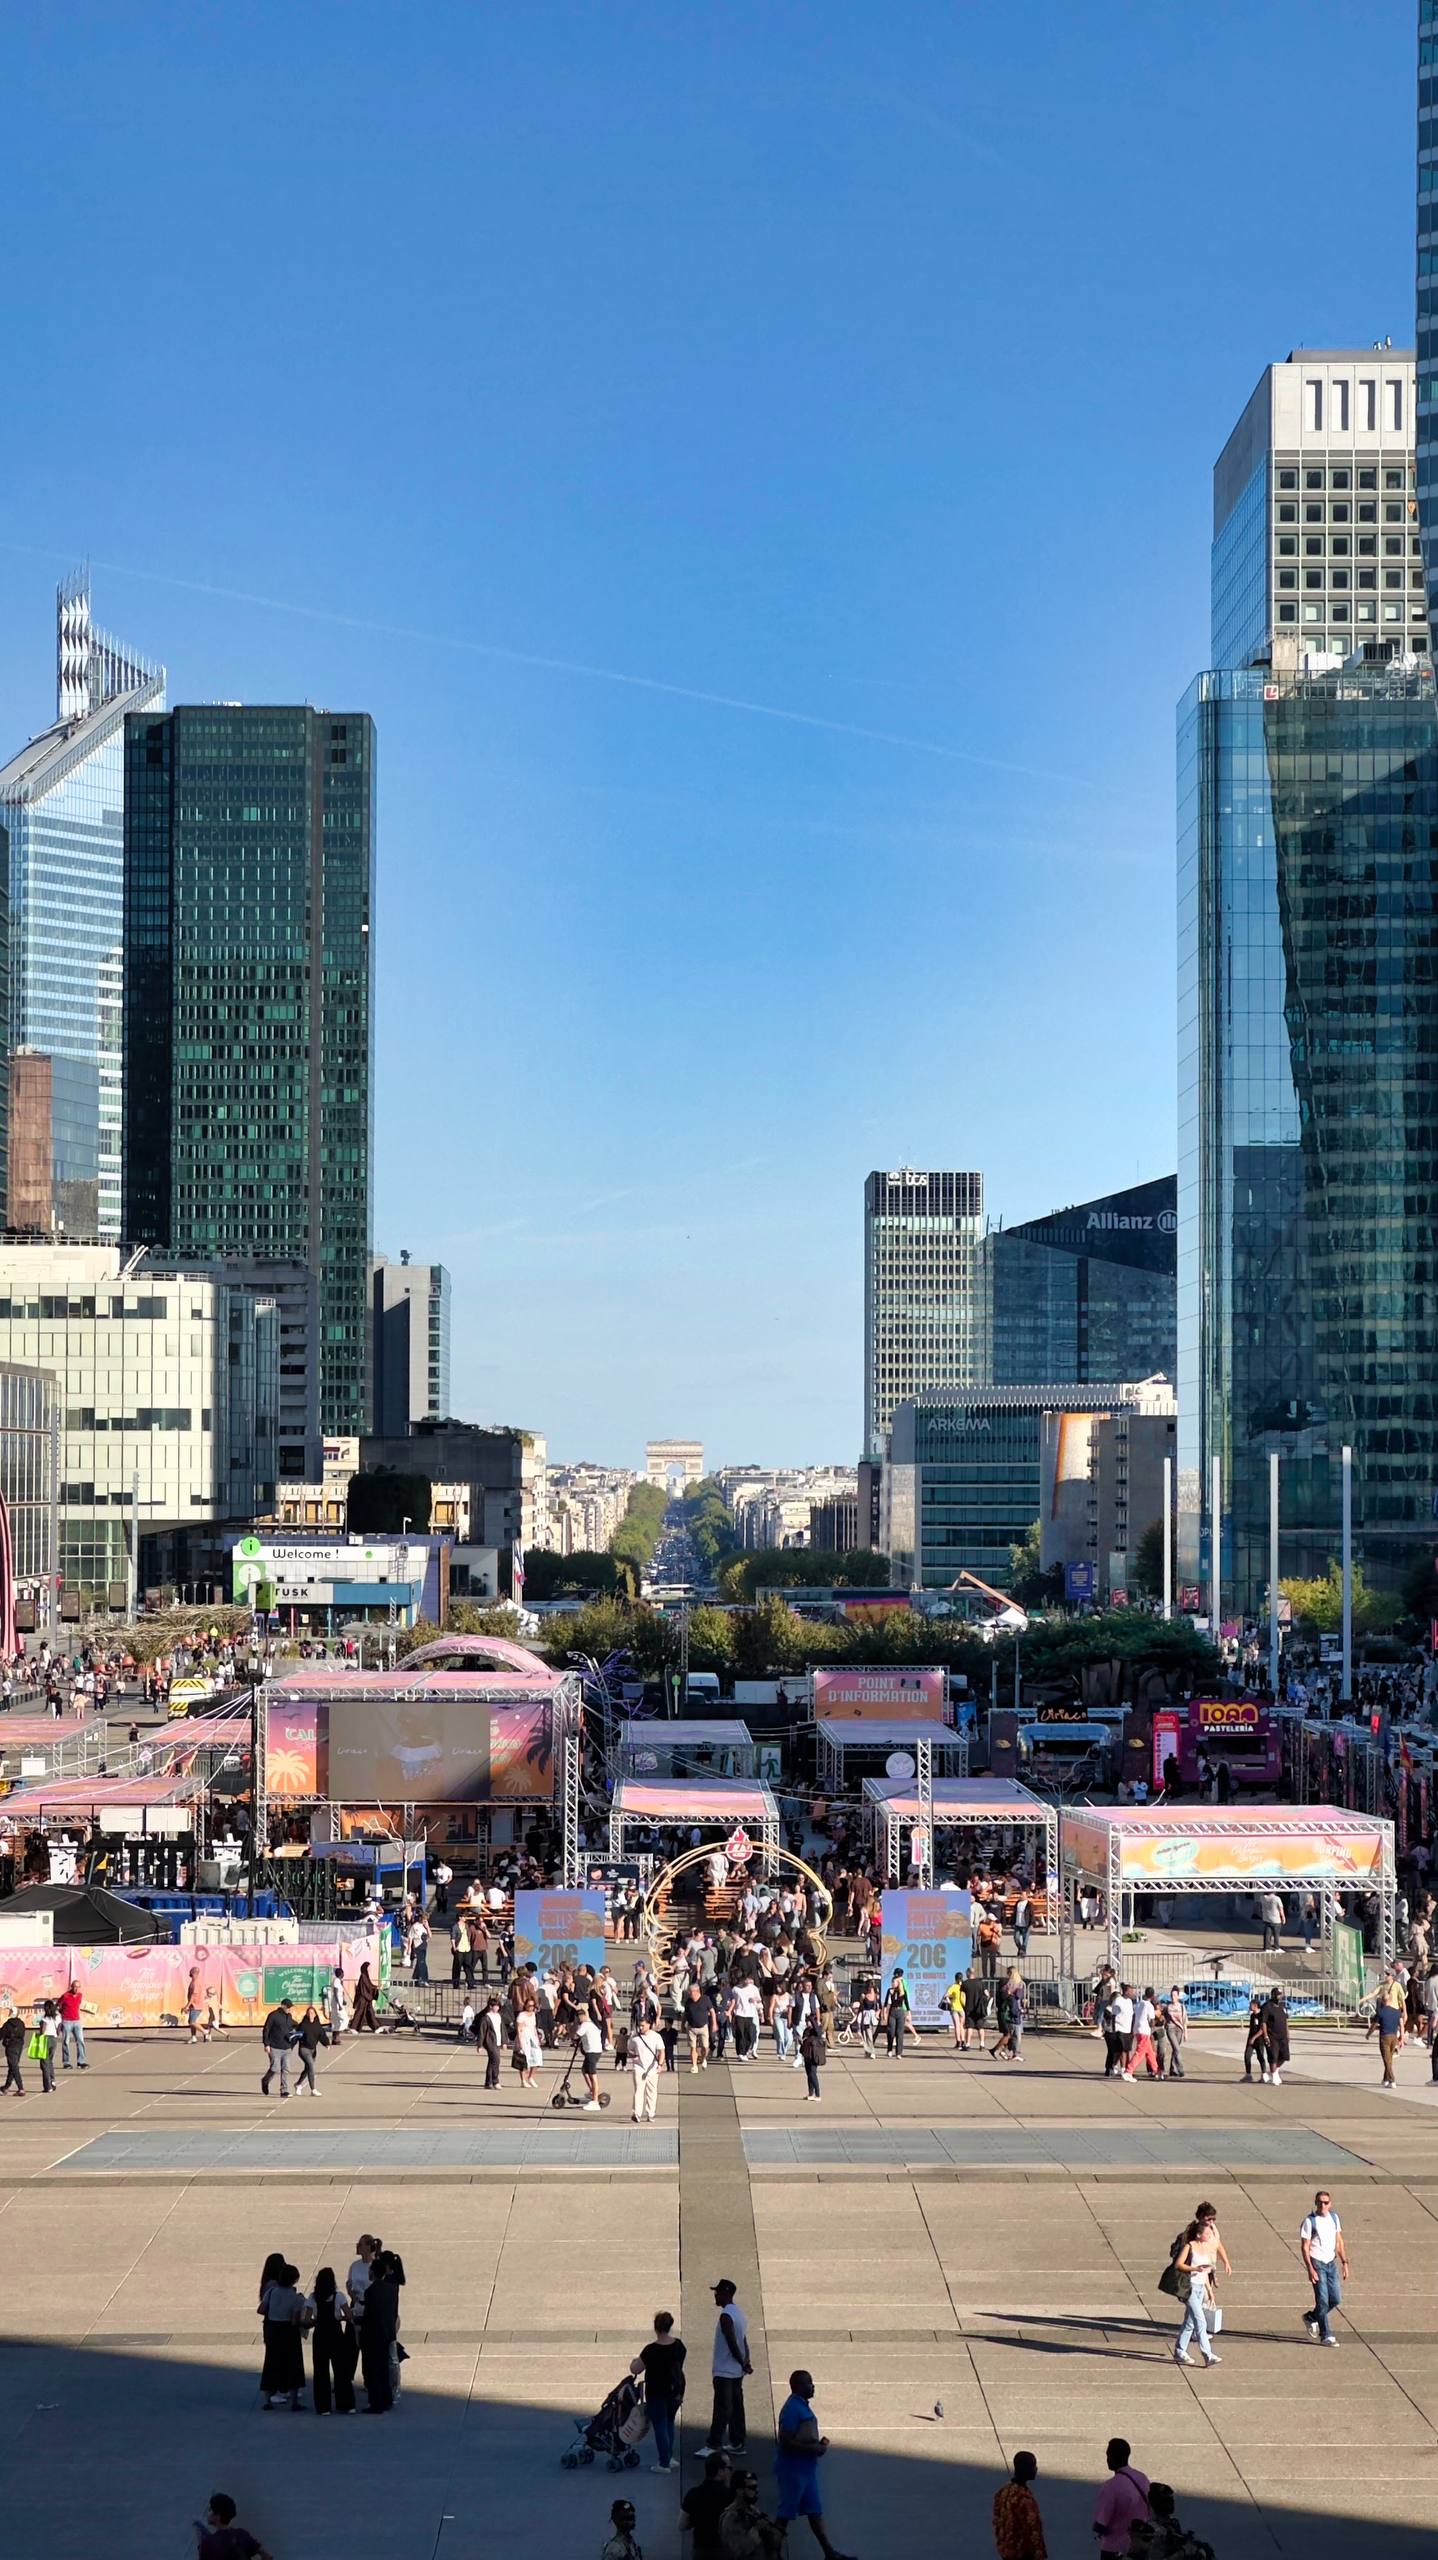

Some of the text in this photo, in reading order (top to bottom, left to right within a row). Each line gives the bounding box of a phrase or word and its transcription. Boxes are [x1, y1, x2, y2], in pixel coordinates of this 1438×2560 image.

[905, 1171, 928, 1186] tcs
[1086, 1212, 1153, 1230] Allianz
[928, 1418, 991, 1431] ARKEMA
[273, 1548, 340, 1559] Welcome !
[275, 1588, 309, 1597] TUSK
[858, 1677, 897, 1690] POINT
[828, 1689, 929, 1703] D'INFORMATION
[1204, 1722, 1254, 1732] PASTELERÍA
